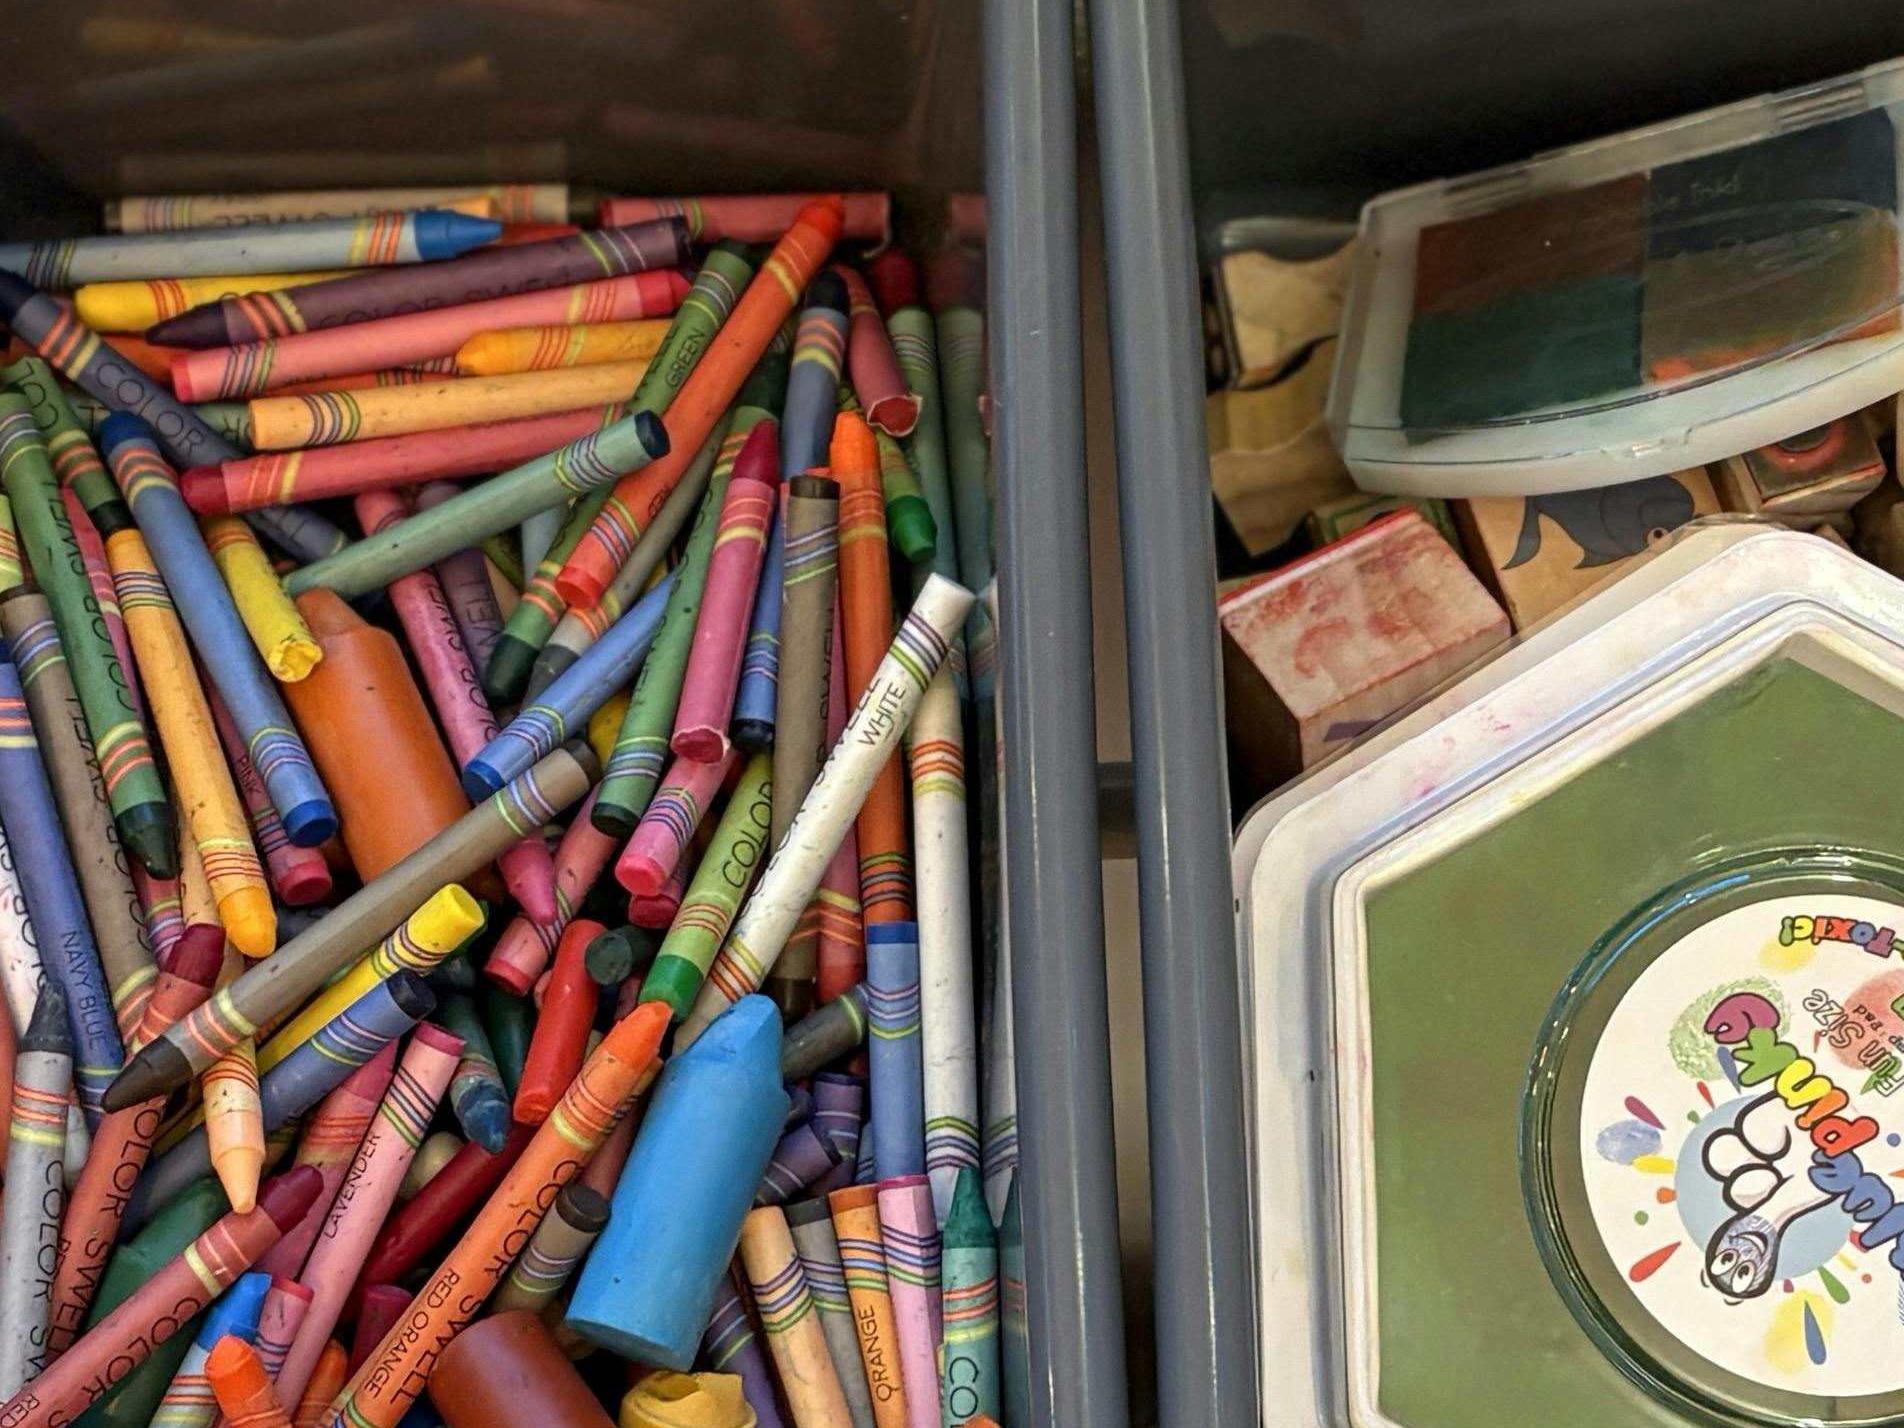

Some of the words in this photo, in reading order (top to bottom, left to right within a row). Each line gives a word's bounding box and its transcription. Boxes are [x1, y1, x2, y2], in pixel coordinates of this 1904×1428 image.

[665, 326, 706, 392] GREEN
[96, 361, 208, 458] COLOR
[856, 683, 908, 748] WHITE
[59, 929, 100, 986] NAVY
[75, 987, 107, 1048] BLUE
[1802, 988, 1866, 1049] Size
[1855, 1003, 1883, 1033] Pad
[36, 1158, 65, 1303] COLOR
[322, 1130, 384, 1241] LAVENDER
[481, 1157, 585, 1276] COLOR
[429, 1266, 462, 1311] RED
[83, 1297, 200, 1405] COLOR
[361, 1308, 433, 1401] ORANGE
[388, 1293, 483, 1406] SWELL
[853, 1303, 897, 1403] ORANGE
